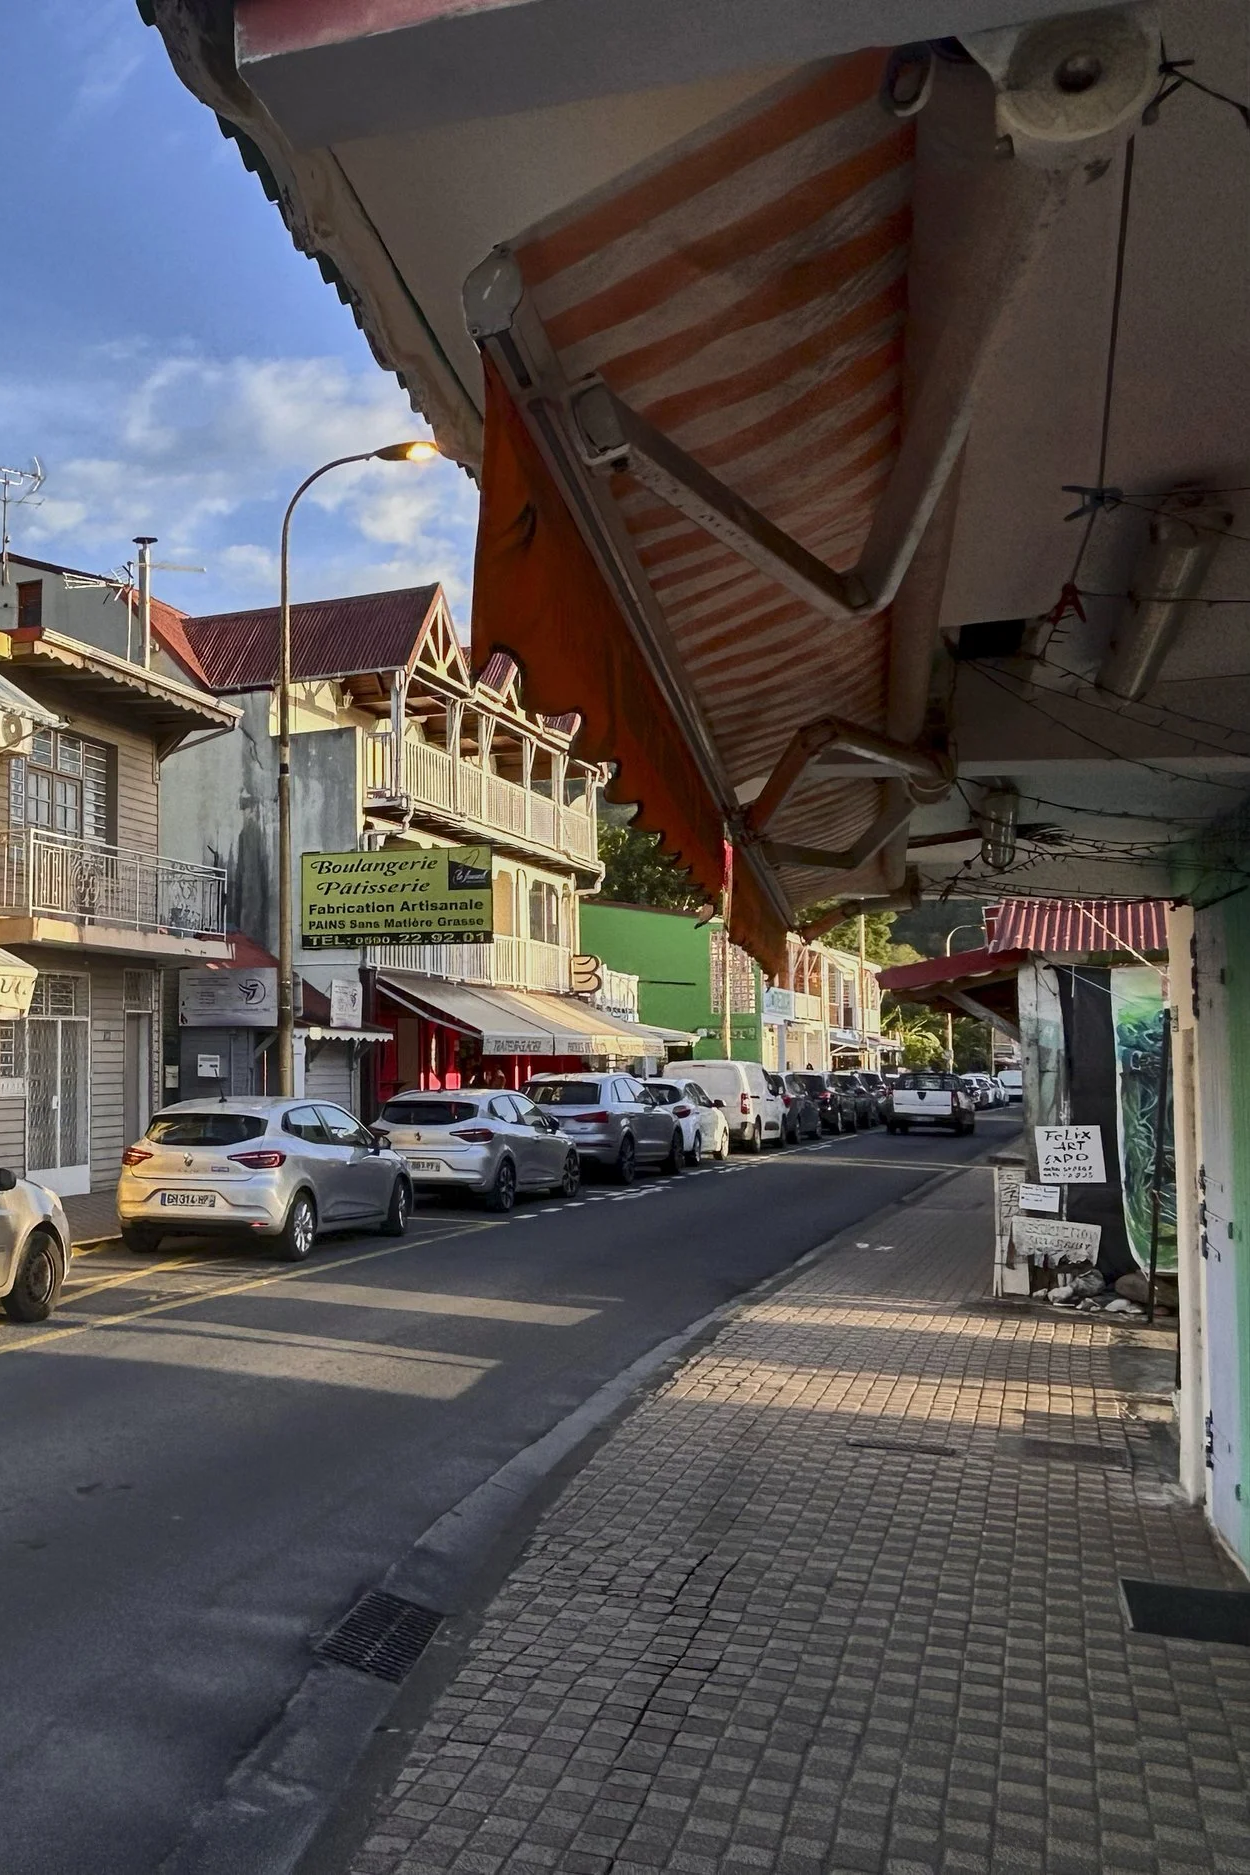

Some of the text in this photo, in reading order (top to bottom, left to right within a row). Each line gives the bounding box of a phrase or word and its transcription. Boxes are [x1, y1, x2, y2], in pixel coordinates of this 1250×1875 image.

[310, 856, 438, 877] Boulangerie
[316, 879, 431, 896] Pâtisserie
[309, 899, 484, 915] Fabrication Artisanale
[308, 916, 484, 930] PAINS Sans Matière Grasse
[309, 935, 351, 946] TEL:
[1053, 1140, 1086, 1151] ART
